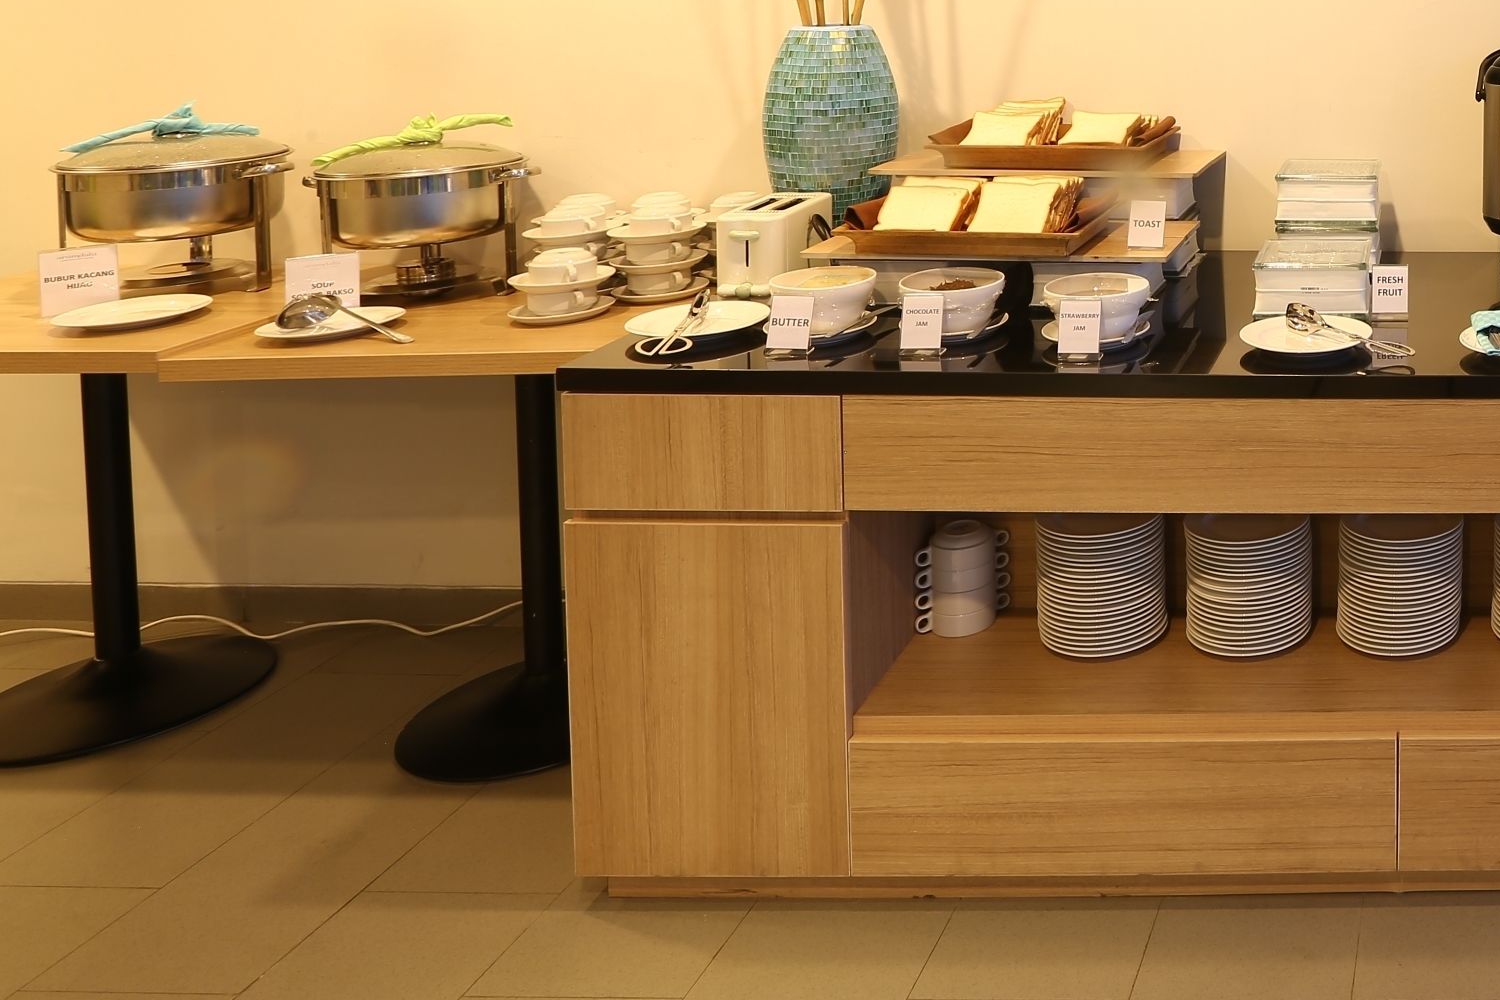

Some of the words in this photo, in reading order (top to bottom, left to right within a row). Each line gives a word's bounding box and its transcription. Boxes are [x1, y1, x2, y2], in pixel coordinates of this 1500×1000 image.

[1134, 220, 1161, 228] TOAST
[44, 274, 76, 283] BUBUR
[77, 270, 115, 280] KACANG
[1377, 276, 1404, 284] FRESH
[326, 288, 354, 296] BAKSO
[1377, 288, 1403, 296] FRUIT
[771, 317, 810, 327] BUTTER
